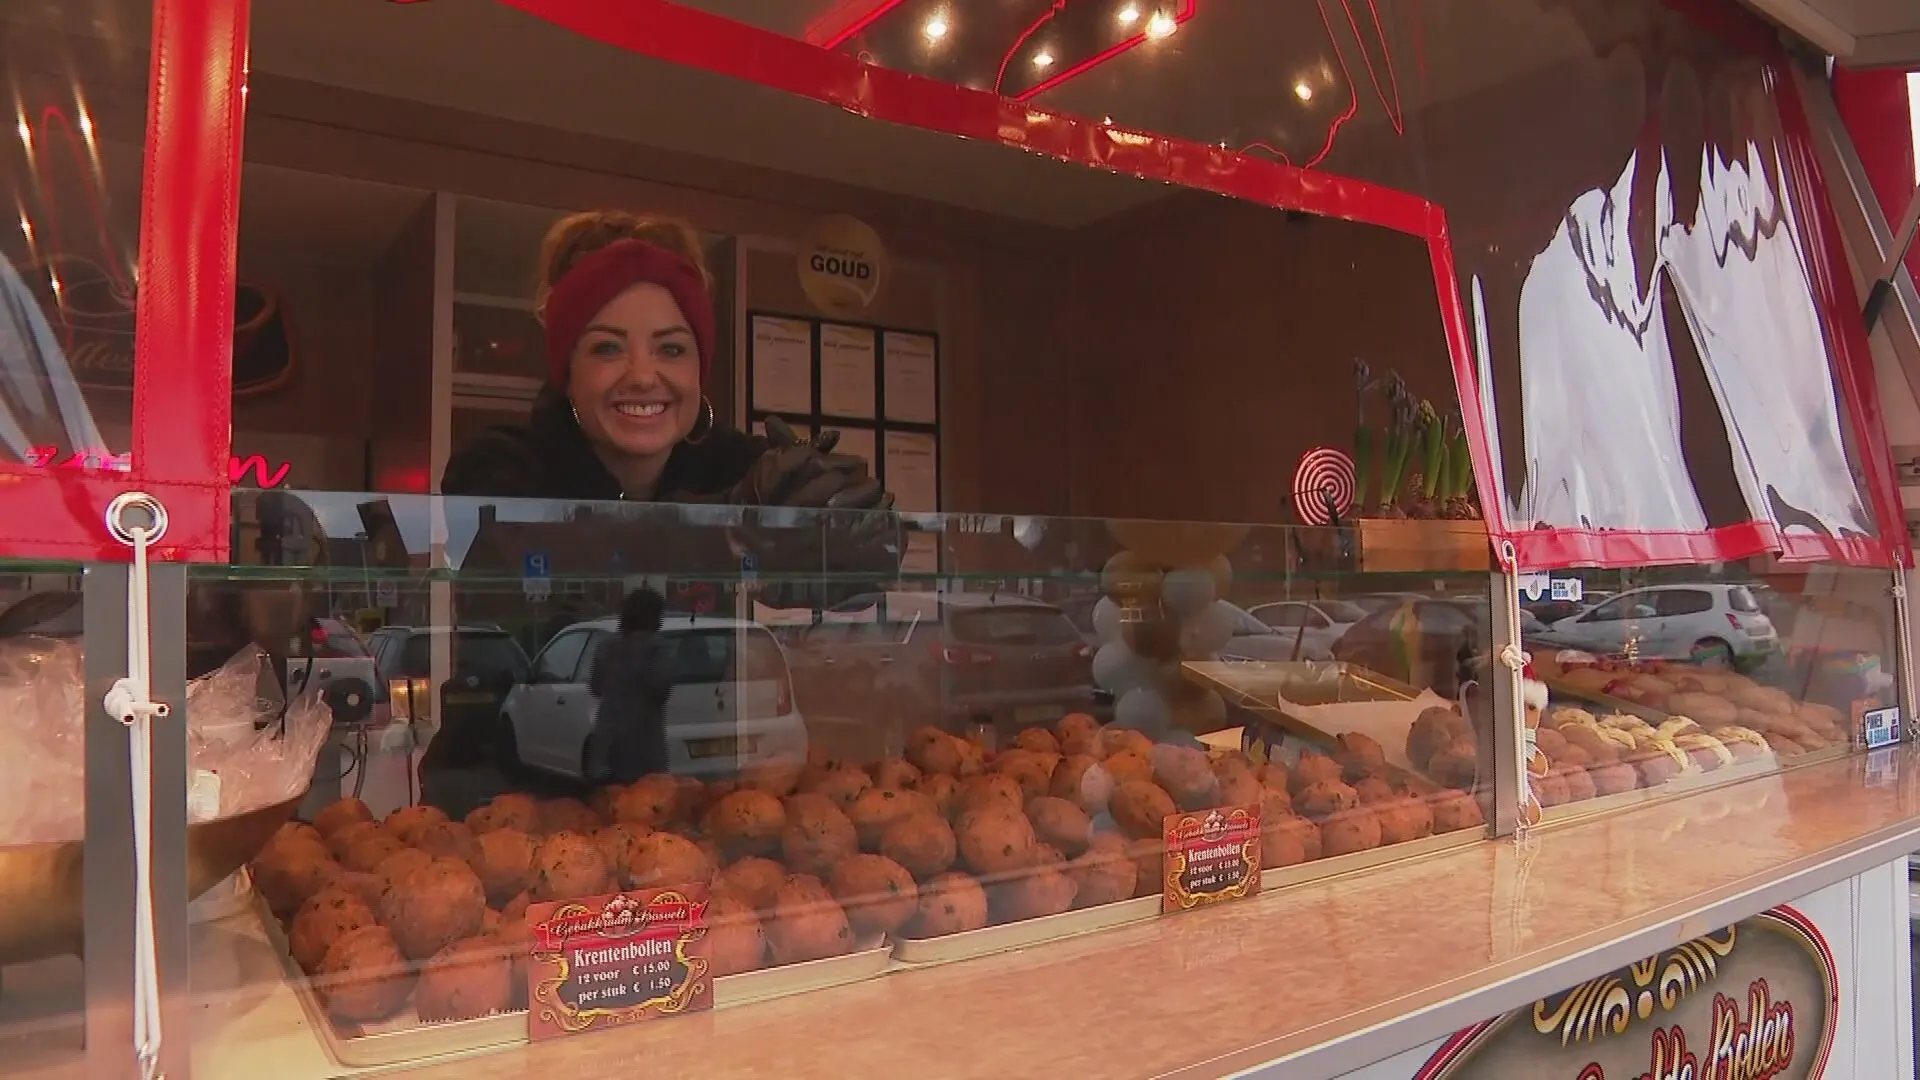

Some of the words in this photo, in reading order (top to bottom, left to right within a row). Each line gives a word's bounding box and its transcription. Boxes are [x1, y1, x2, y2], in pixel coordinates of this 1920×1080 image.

[811, 254, 870, 280] GOUD
[1188, 843, 1241, 863] Krentenbollen
[1198, 865, 1213, 873] voor
[1190, 879, 1201, 889] per
[574, 939, 672, 967] Krentenbollen
[578, 974, 591, 985] 12
[593, 969, 620, 982] voor
[632, 965, 640, 975] €
[643, 960, 671, 975] 15.00
[578, 989, 598, 1004] per
[601, 983, 627, 998] stuk
[632, 981, 640, 993] €
[650, 977, 671, 990] 1.50
